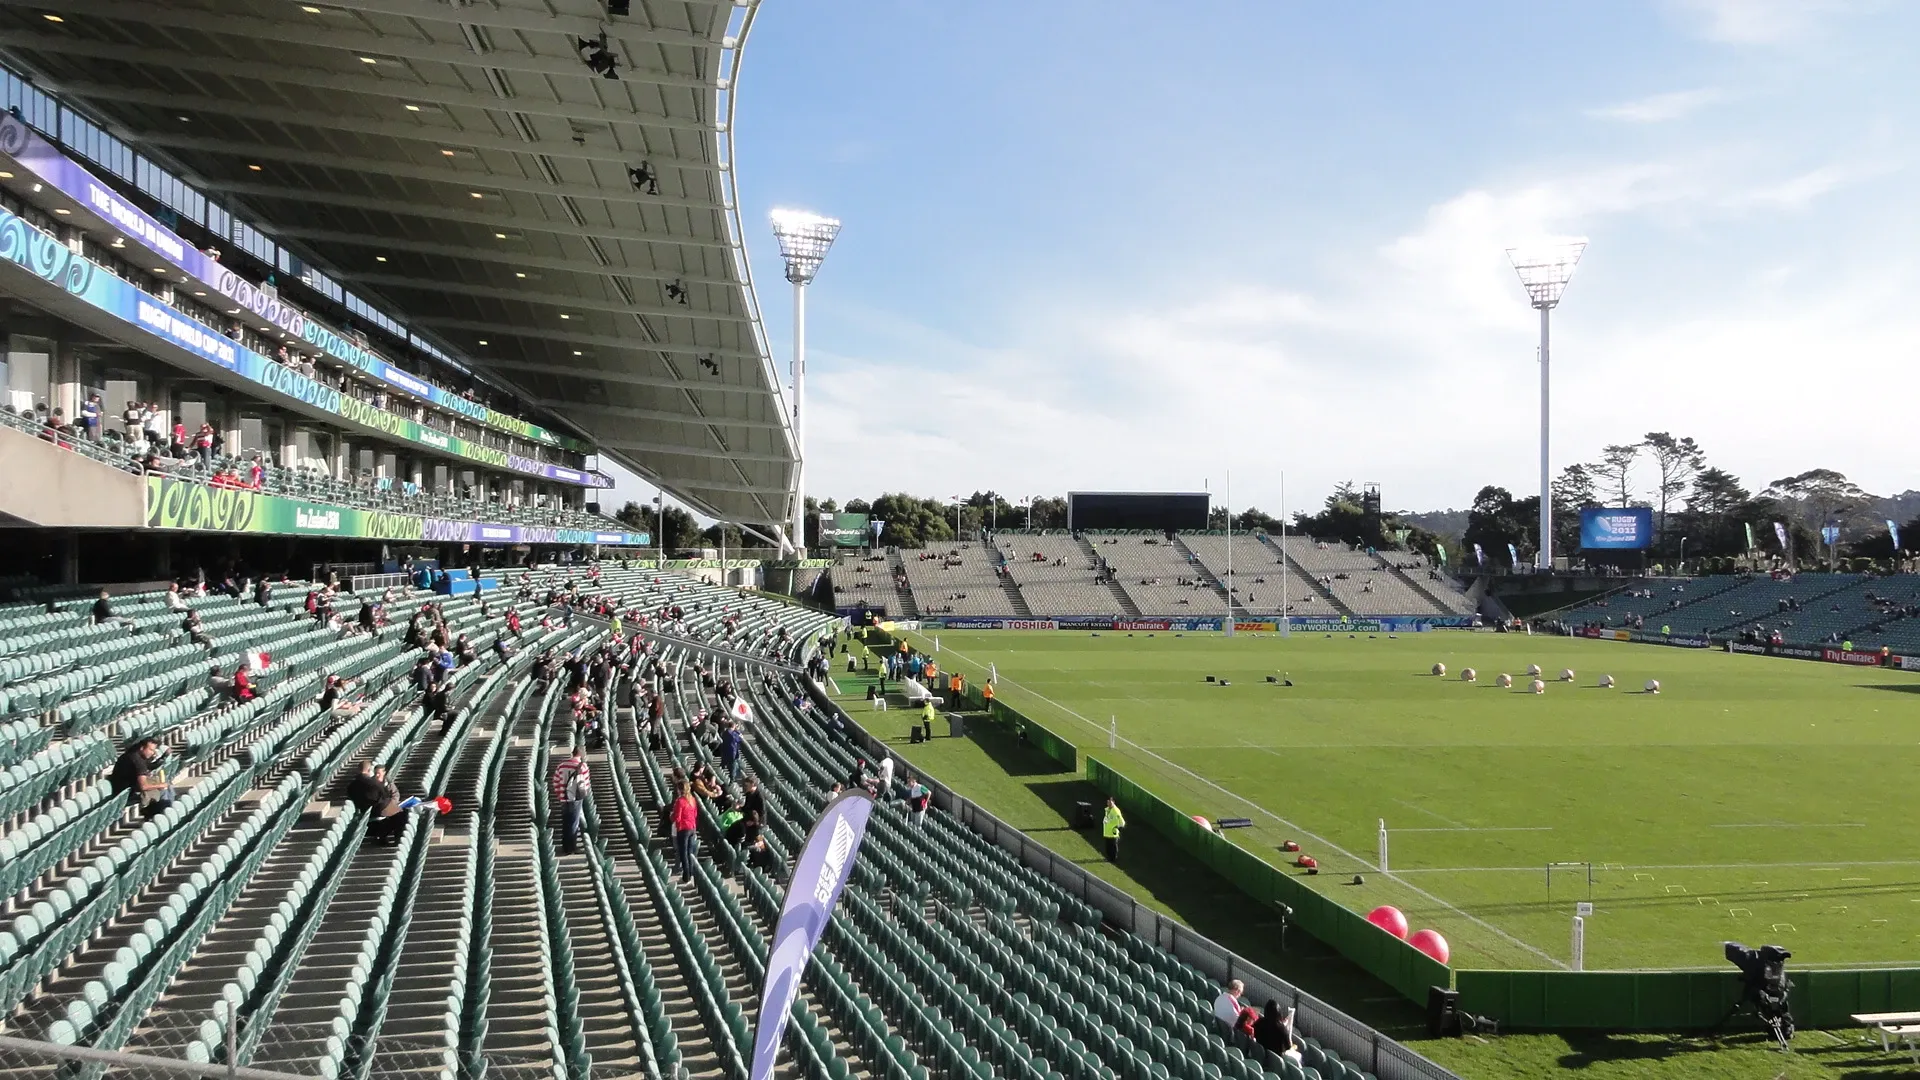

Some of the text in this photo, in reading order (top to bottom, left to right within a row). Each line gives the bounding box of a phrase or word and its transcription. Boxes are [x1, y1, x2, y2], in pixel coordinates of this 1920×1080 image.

[90, 183, 110, 213] THE
[139, 301, 171, 332] RUGBY
[1007, 621, 1054, 630] TOSHIBA
[1118, 622, 1164, 631] Fly Emirates
[1234, 623, 1264, 631] DHL
[1733, 643, 1766, 654] BlackBerry
[1794, 649, 1811, 657] ROVER
[1827, 651, 1876, 664] Fly Emirates
